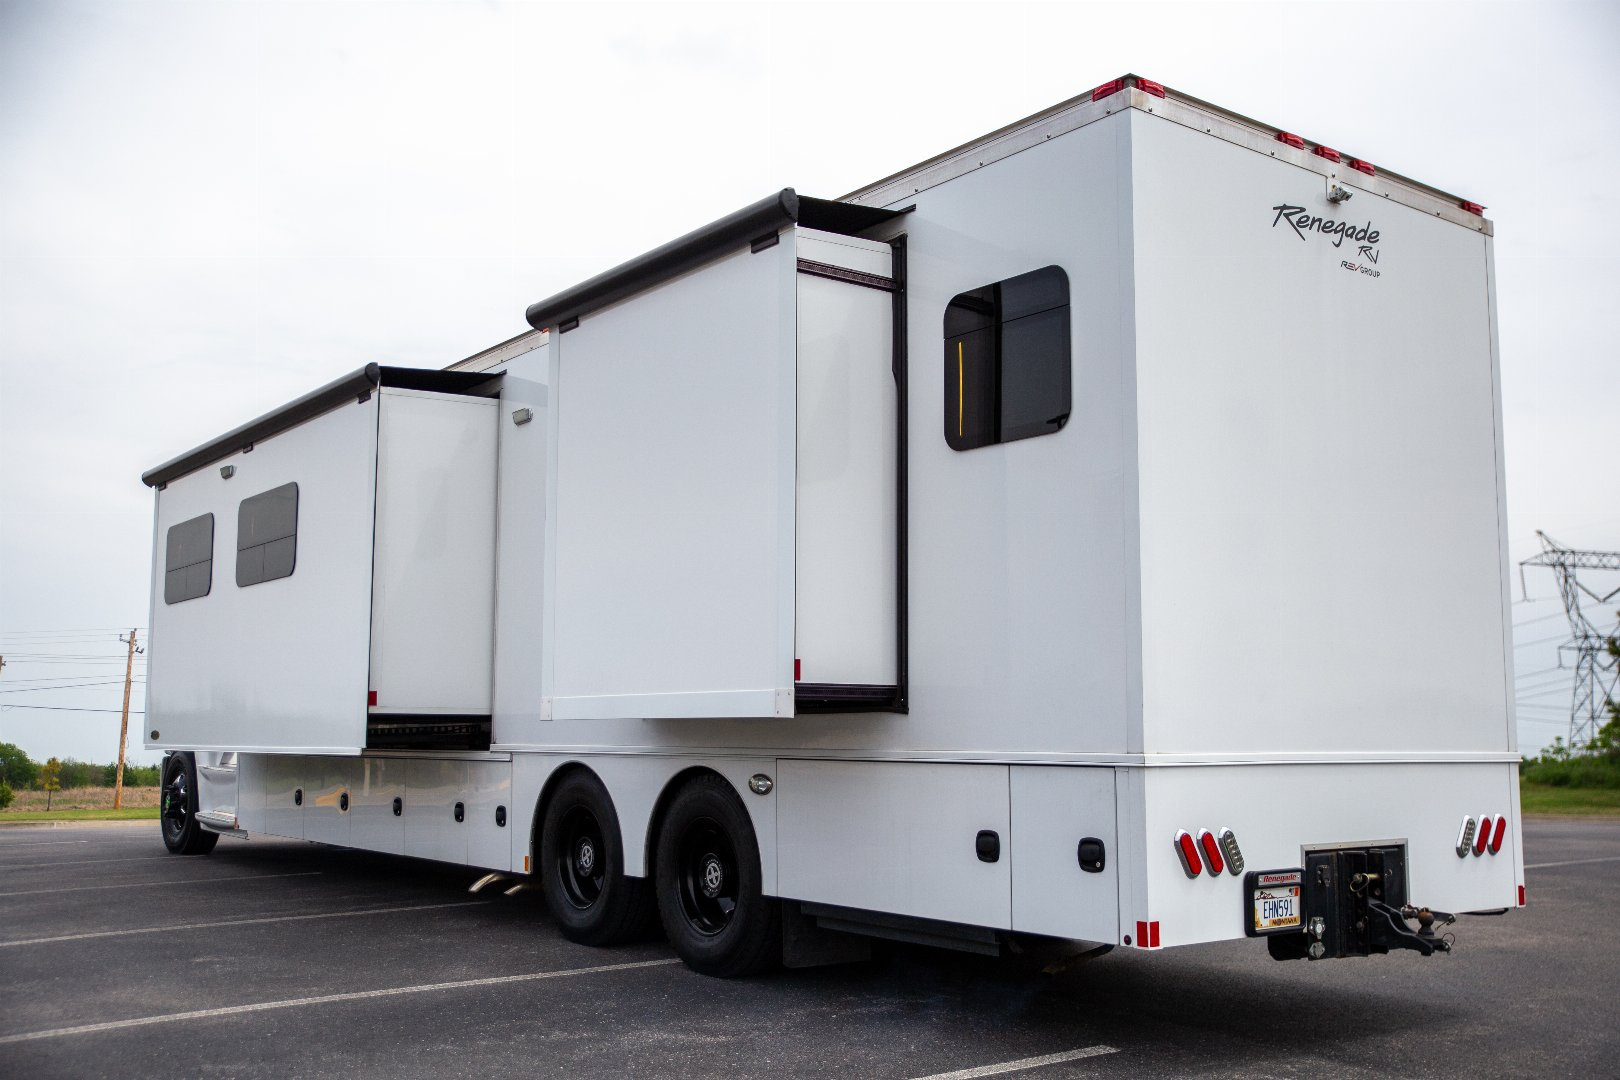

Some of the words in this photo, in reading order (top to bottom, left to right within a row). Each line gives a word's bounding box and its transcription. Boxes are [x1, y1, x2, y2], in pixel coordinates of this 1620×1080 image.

[1272, 203, 1380, 248] Renegade
[1357, 245, 1379, 264] RV
[1360, 266, 1380, 278] GROUP
[1263, 873, 1297, 882] Renegade
[1263, 899, 1294, 919] EHN591
[1272, 917, 1298, 926] MONTANA
